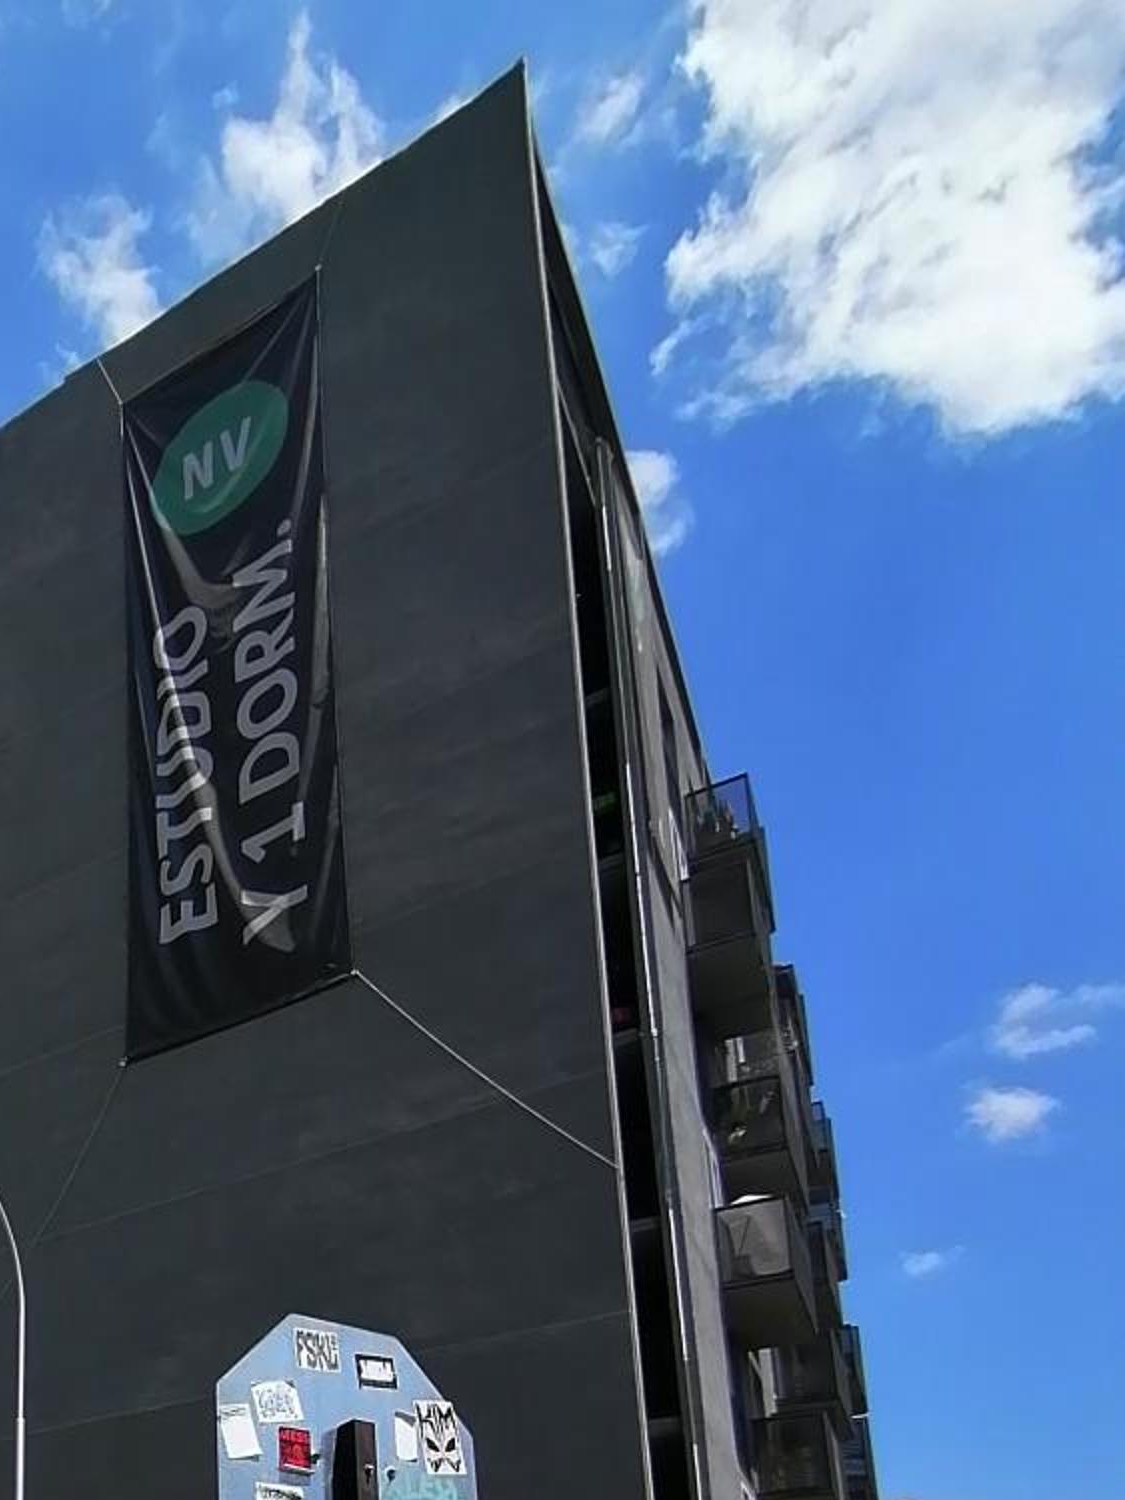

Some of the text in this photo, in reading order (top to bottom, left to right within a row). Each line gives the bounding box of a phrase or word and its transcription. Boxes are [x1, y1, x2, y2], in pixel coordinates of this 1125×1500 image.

[182, 416, 252, 501] NV
[153, 605, 219, 943] ESTUDIO
[232, 518, 308, 945] Y 1 DORM.
